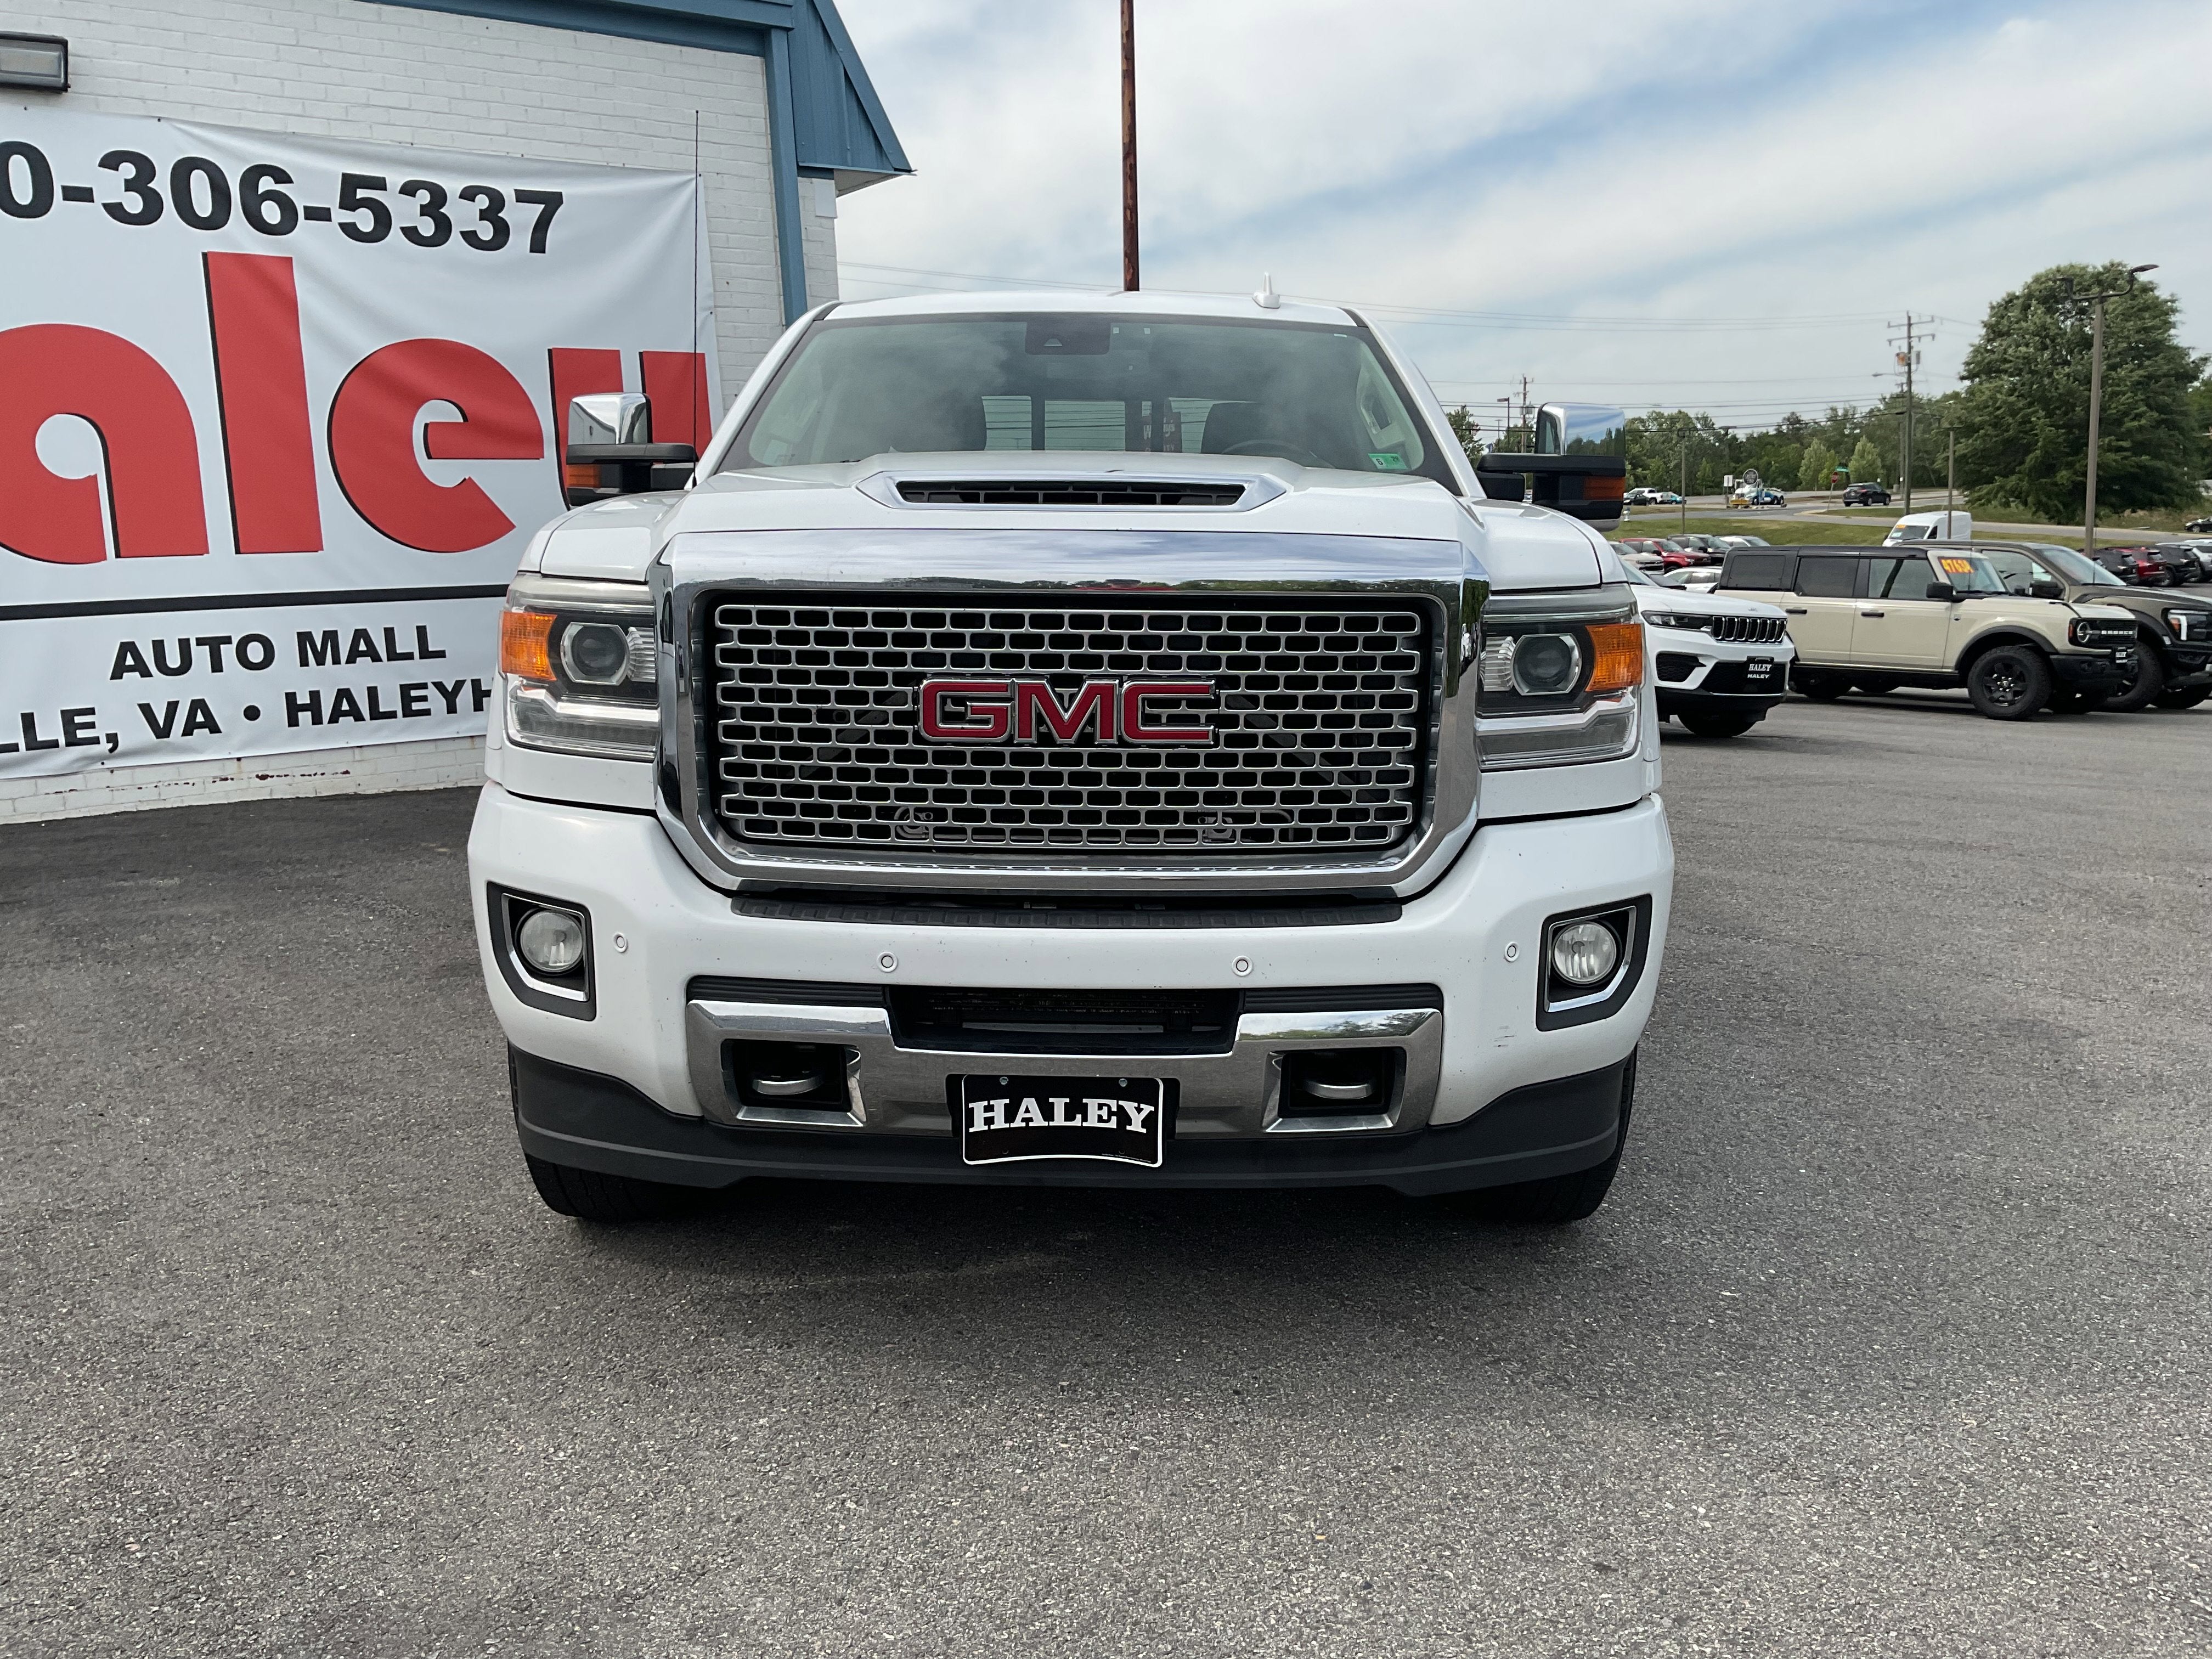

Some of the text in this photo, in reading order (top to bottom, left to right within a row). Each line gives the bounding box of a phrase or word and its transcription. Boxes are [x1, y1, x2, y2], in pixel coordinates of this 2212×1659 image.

[0, 141, 565, 254] 0-306-5337
[110, 625, 447, 680] AUTO MALL
[138, 698, 222, 739] VA
[918, 678, 1216, 744] GMC
[968, 1097, 1155, 1134] HALEY
